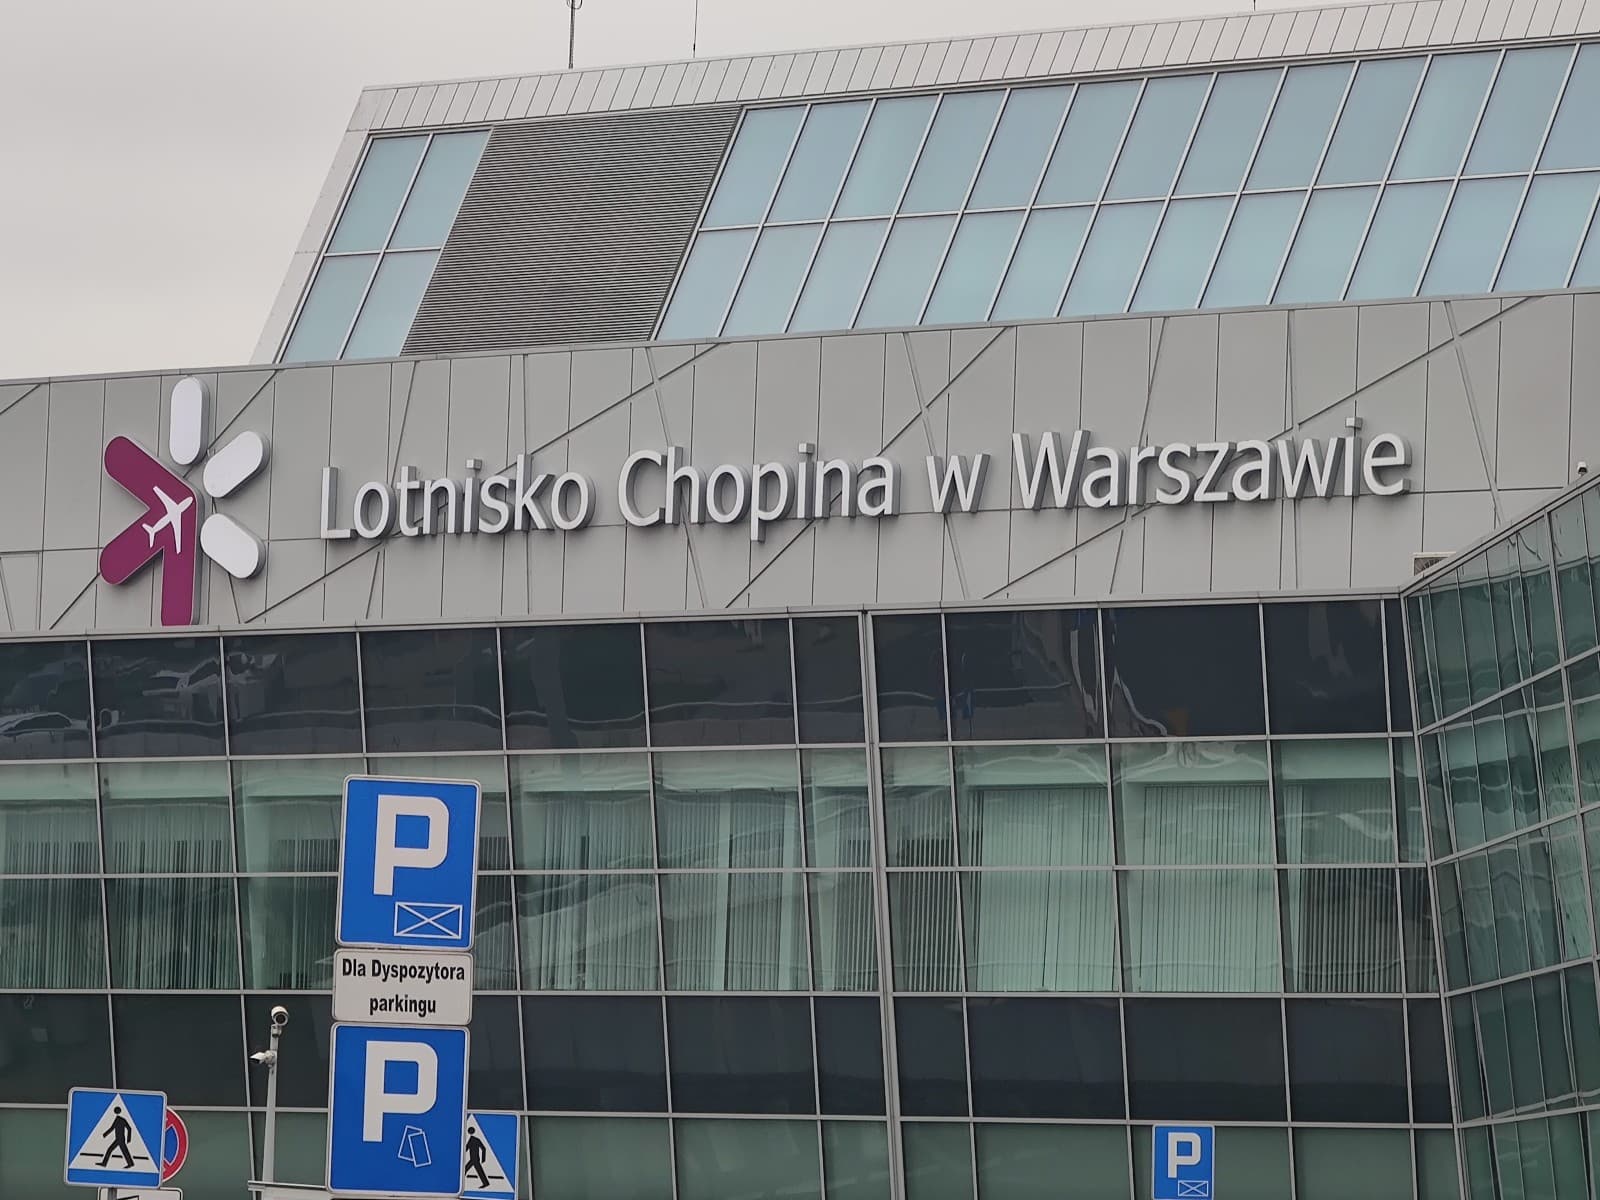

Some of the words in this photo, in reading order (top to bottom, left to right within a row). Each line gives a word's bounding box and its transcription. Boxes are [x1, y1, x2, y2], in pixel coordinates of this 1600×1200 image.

[320, 453, 596, 541] Lotnisko
[618, 442, 901, 543] Chopina
[926, 453, 990, 513] w
[1012, 416, 1413, 510] Warszawie
[373, 793, 450, 897] P
[342, 959, 366, 978] Dla
[371, 960, 466, 984] Dyspozytora
[369, 994, 437, 1017] parkingu
[362, 1040, 438, 1143] P
[1167, 1132, 1202, 1179] P
